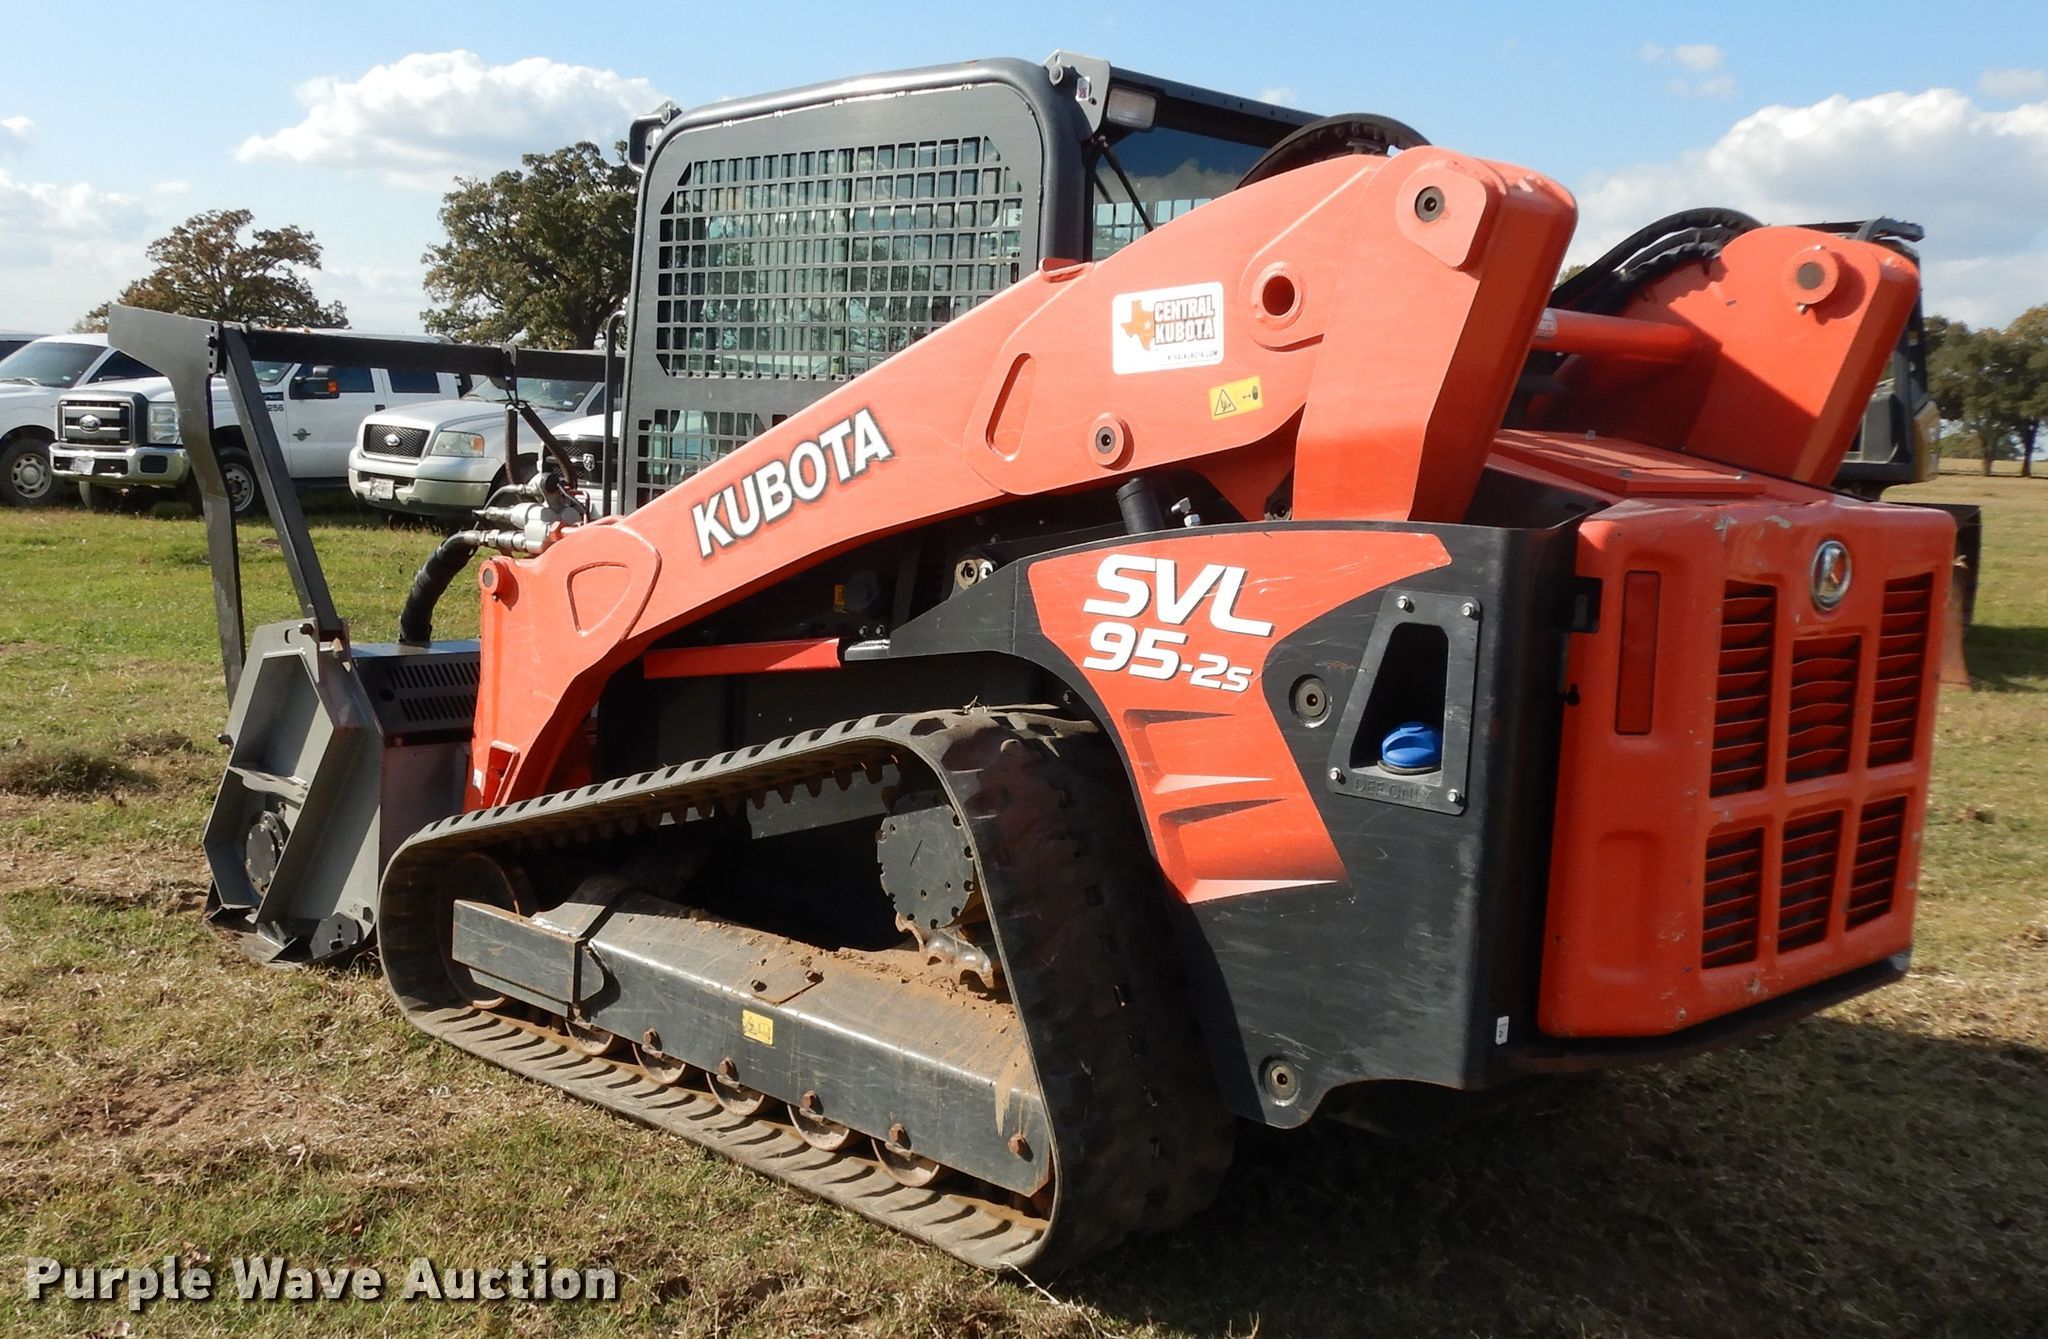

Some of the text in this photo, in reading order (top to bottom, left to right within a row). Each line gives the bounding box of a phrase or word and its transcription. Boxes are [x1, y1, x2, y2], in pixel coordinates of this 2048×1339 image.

[1153, 295, 1216, 323] CENTRAL
[1153, 317, 1216, 345] KUBOTA
[691, 407, 894, 559] KUBOTA
[1082, 553, 1274, 639] SVL
